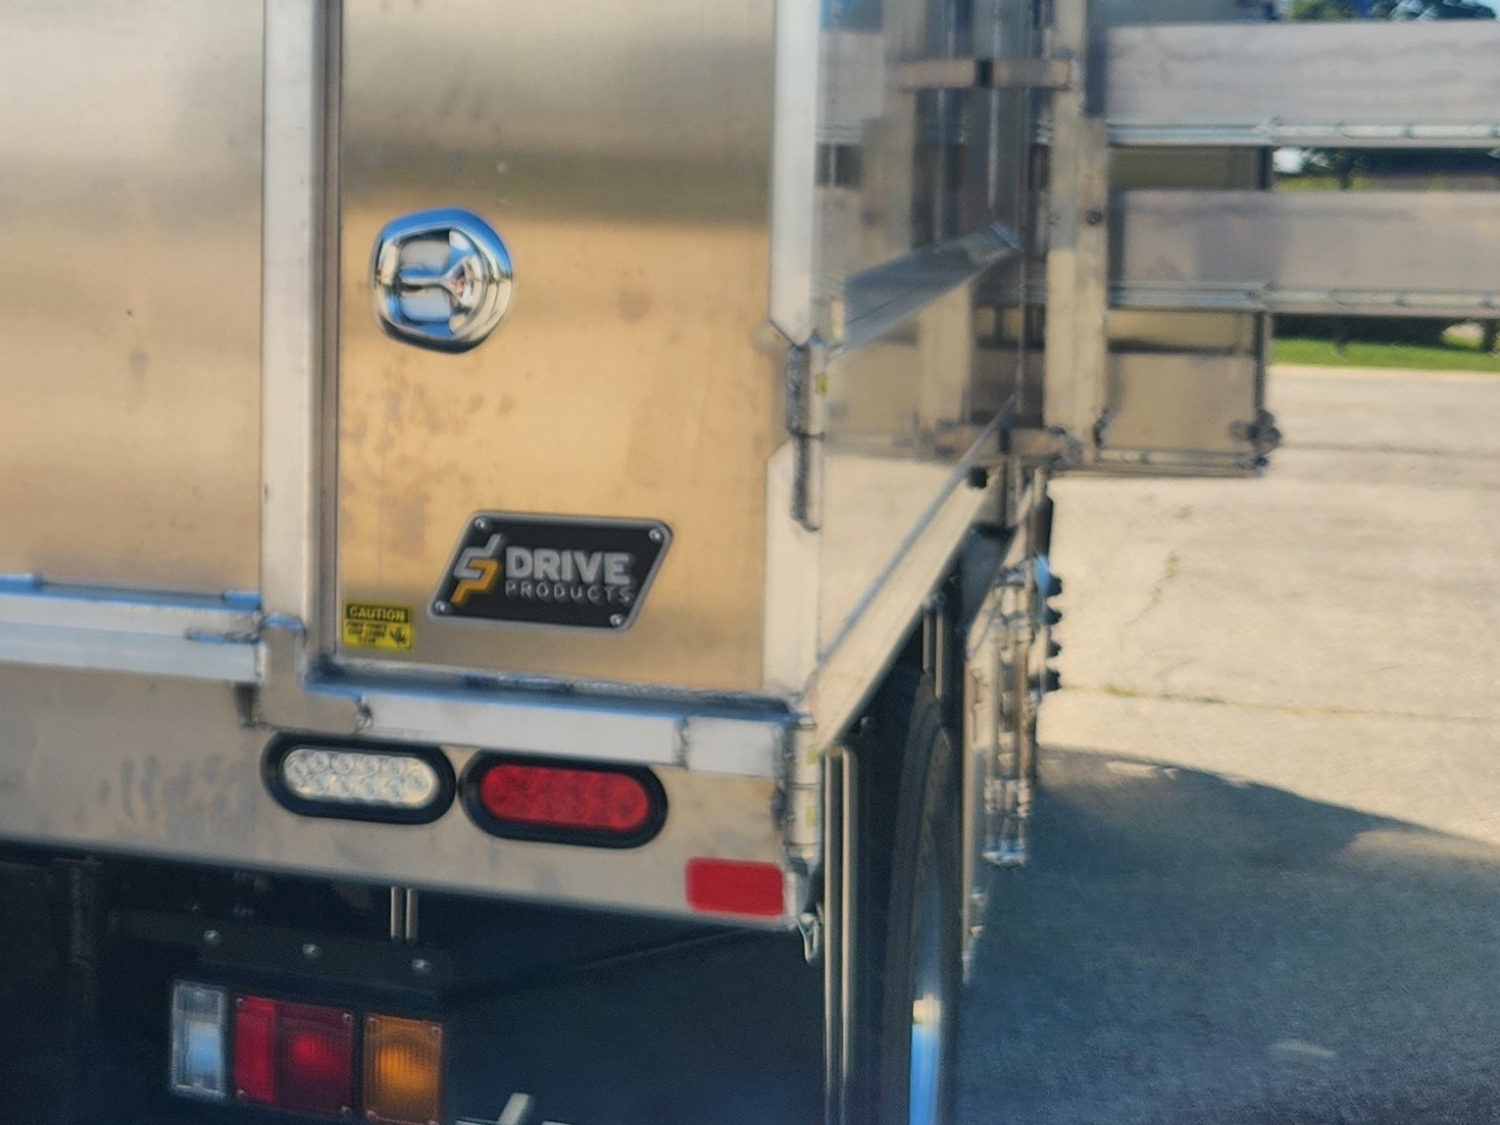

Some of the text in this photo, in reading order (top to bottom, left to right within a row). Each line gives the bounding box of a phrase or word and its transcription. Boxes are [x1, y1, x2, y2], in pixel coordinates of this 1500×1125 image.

[505, 546, 631, 585] DRIVE
[505, 580, 631, 604] PRODUCTS
[349, 606, 405, 622] CAUTION
